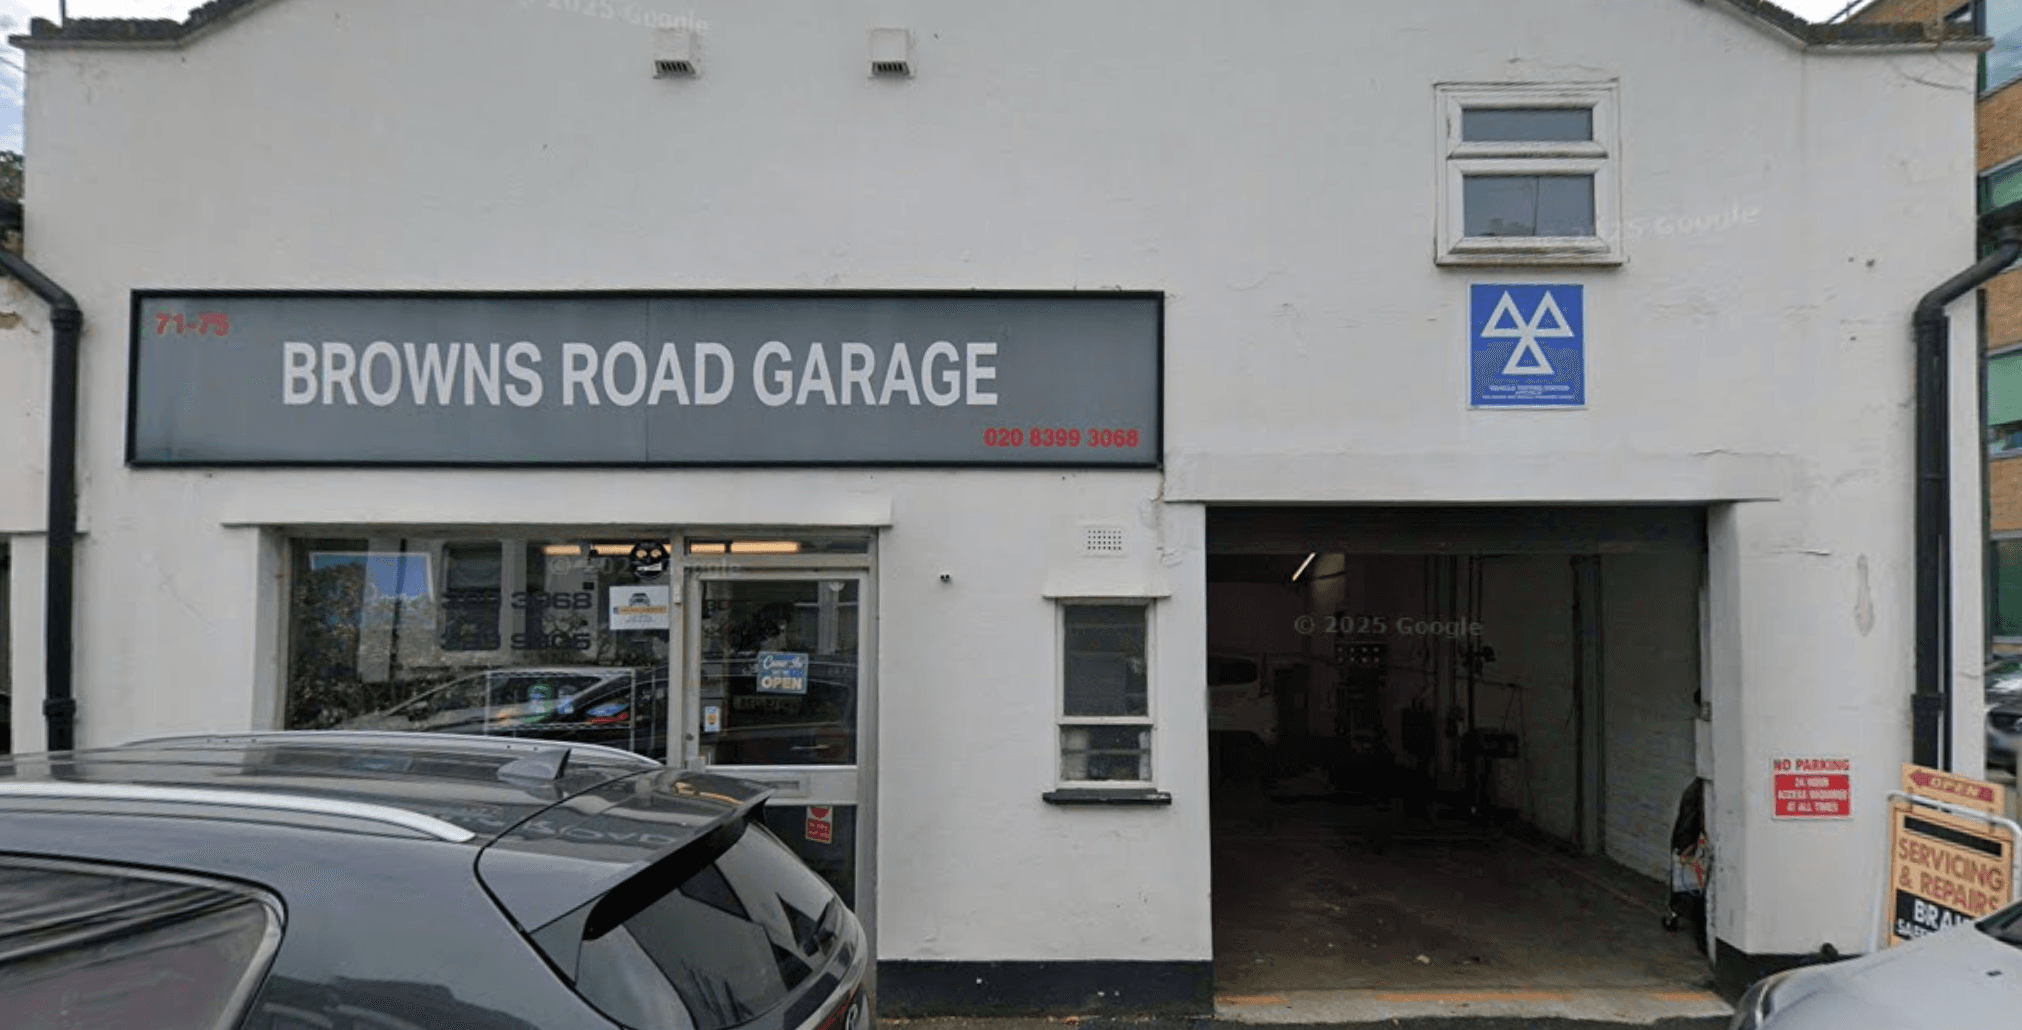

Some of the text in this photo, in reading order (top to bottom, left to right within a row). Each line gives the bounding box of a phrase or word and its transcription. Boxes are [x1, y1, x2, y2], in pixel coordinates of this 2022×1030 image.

[282, 340, 999, 407] BROWNS ROAD GARAGE
[983, 427, 1141, 449] 020 8399 3068
[761, 675, 802, 691] OPEN
[1773, 758, 1850, 771] NO PARKING
[1898, 837, 2005, 892] SERVICING
[1899, 865, 1914, 889] &
